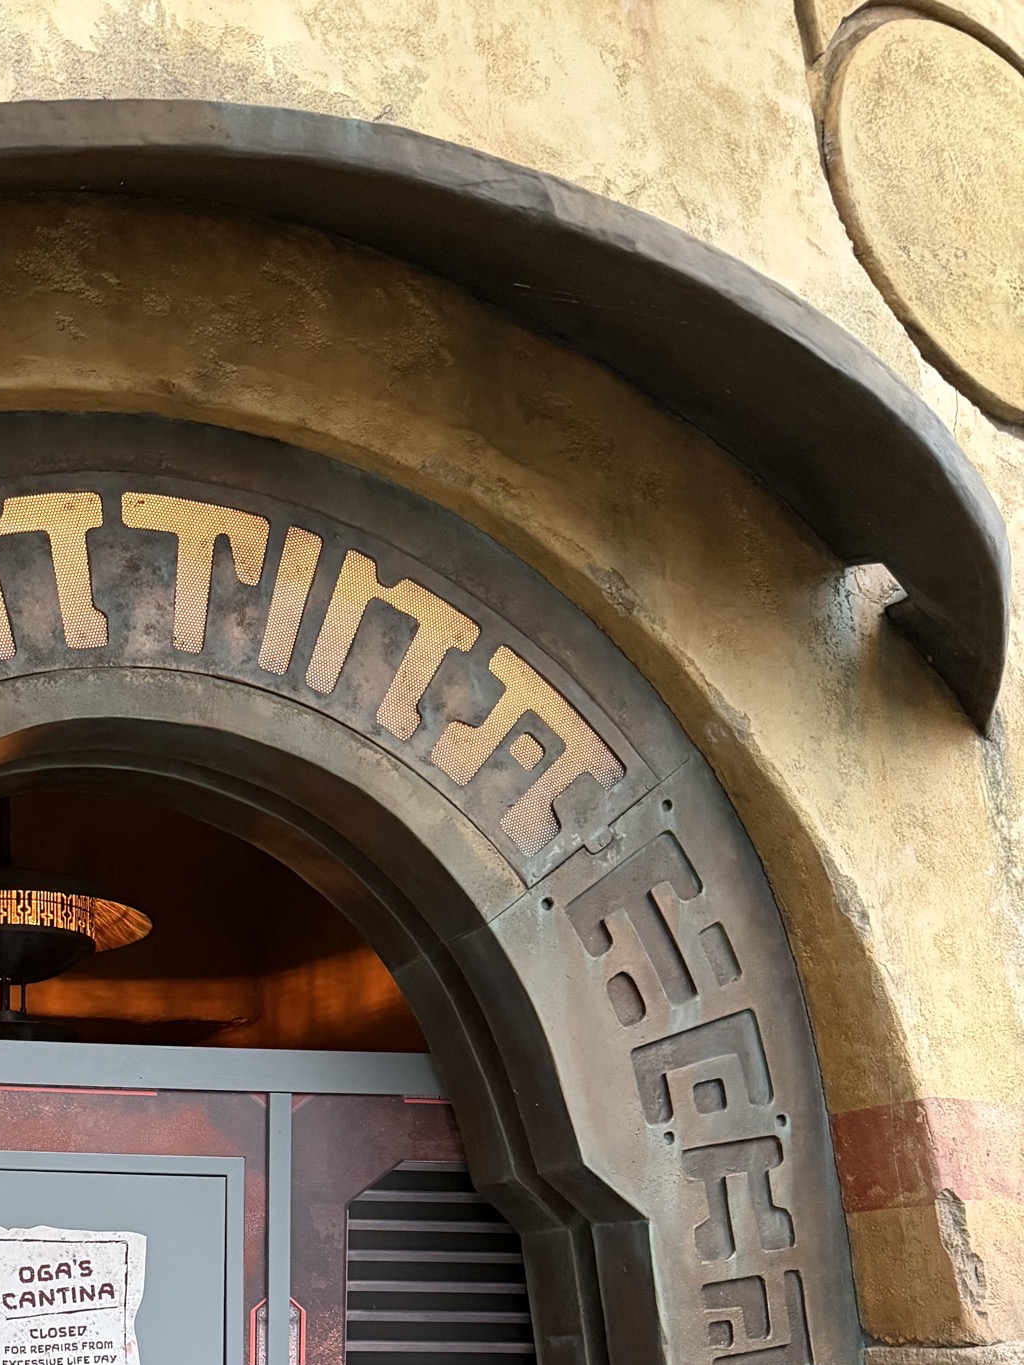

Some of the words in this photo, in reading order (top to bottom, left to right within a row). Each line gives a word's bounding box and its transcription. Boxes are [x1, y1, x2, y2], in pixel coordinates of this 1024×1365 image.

[18, 1259, 93, 1283] OGA'S
[2, 1283, 115, 1310] CANTINA
[29, 1326, 87, 1339] CLOSED
[4, 1345, 27, 1354] FOR
[30, 1343, 78, 1353] REPAIRS
[82, 1341, 113, 1350] FROM
[67, 1356, 89, 1365] LIFE
[94, 1355, 117, 1364] DAY
